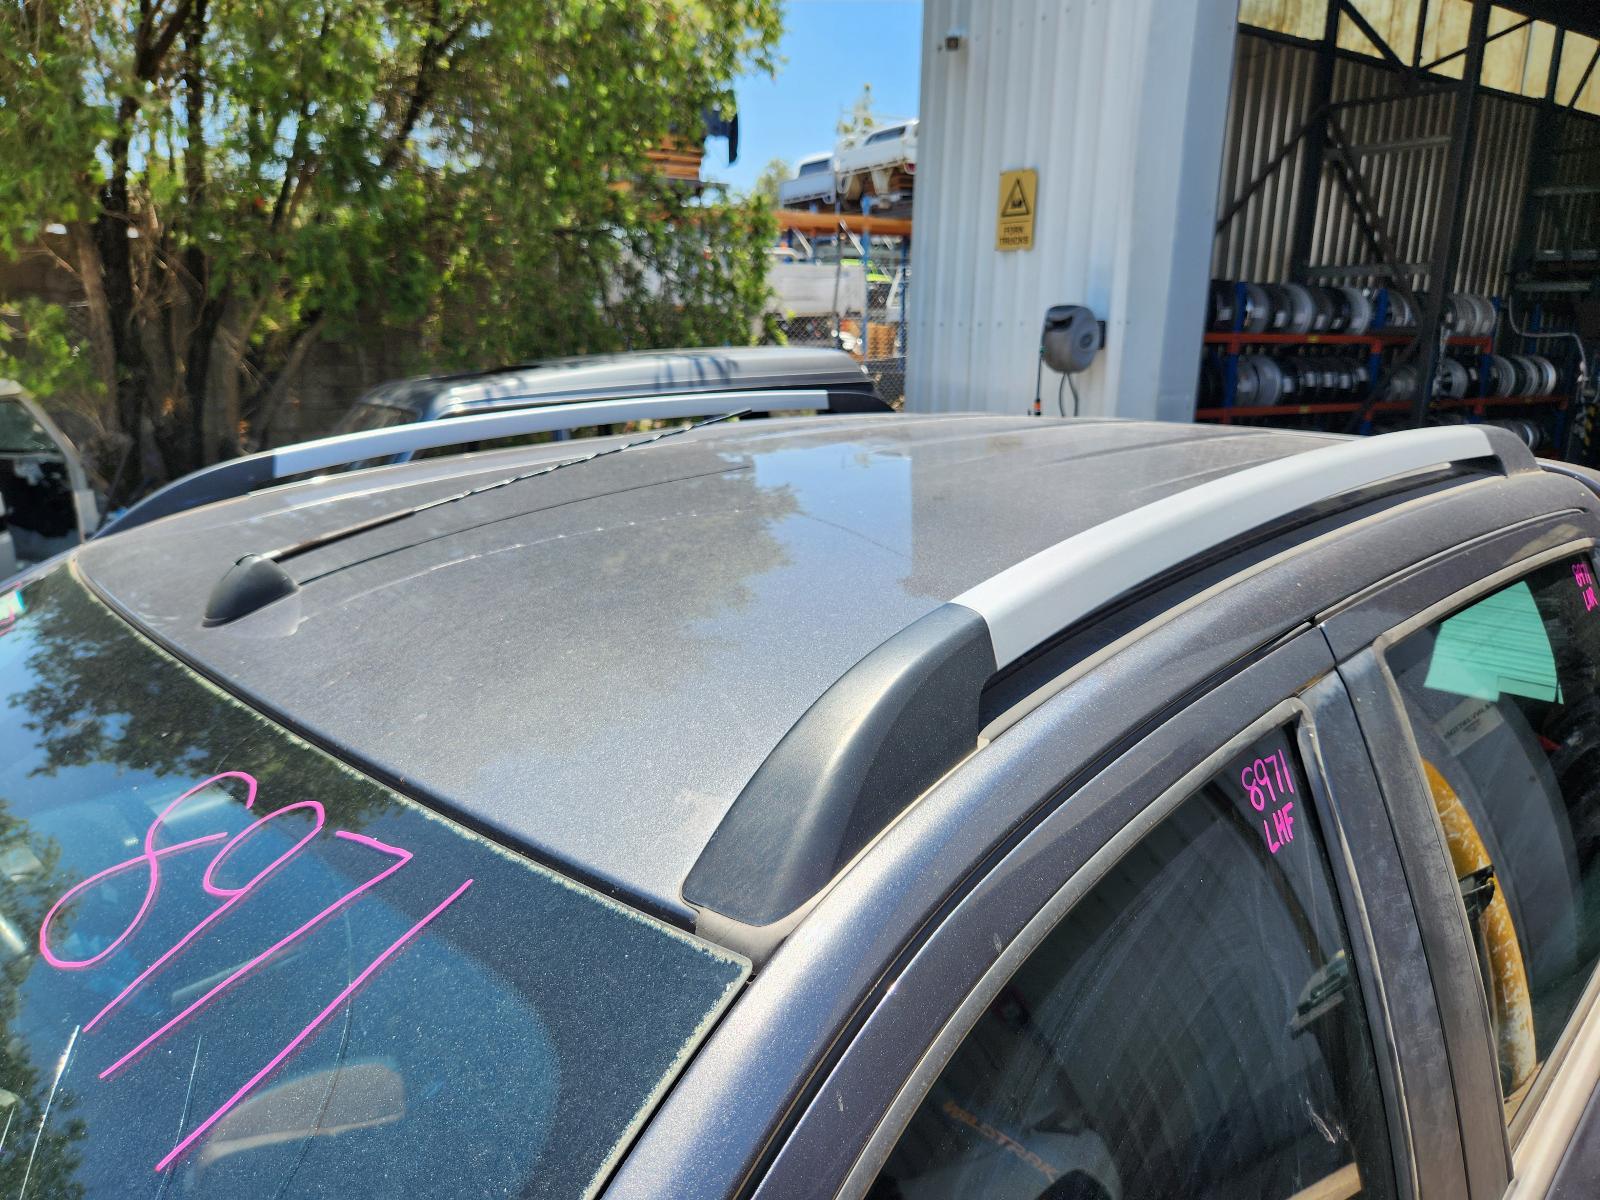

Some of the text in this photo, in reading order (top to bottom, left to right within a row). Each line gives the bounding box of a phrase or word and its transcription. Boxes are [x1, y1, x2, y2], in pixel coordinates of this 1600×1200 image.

[1241, 748, 1295, 812] 8971
[1263, 801, 1294, 854] LHF
[39, 770, 475, 1173] 8971
